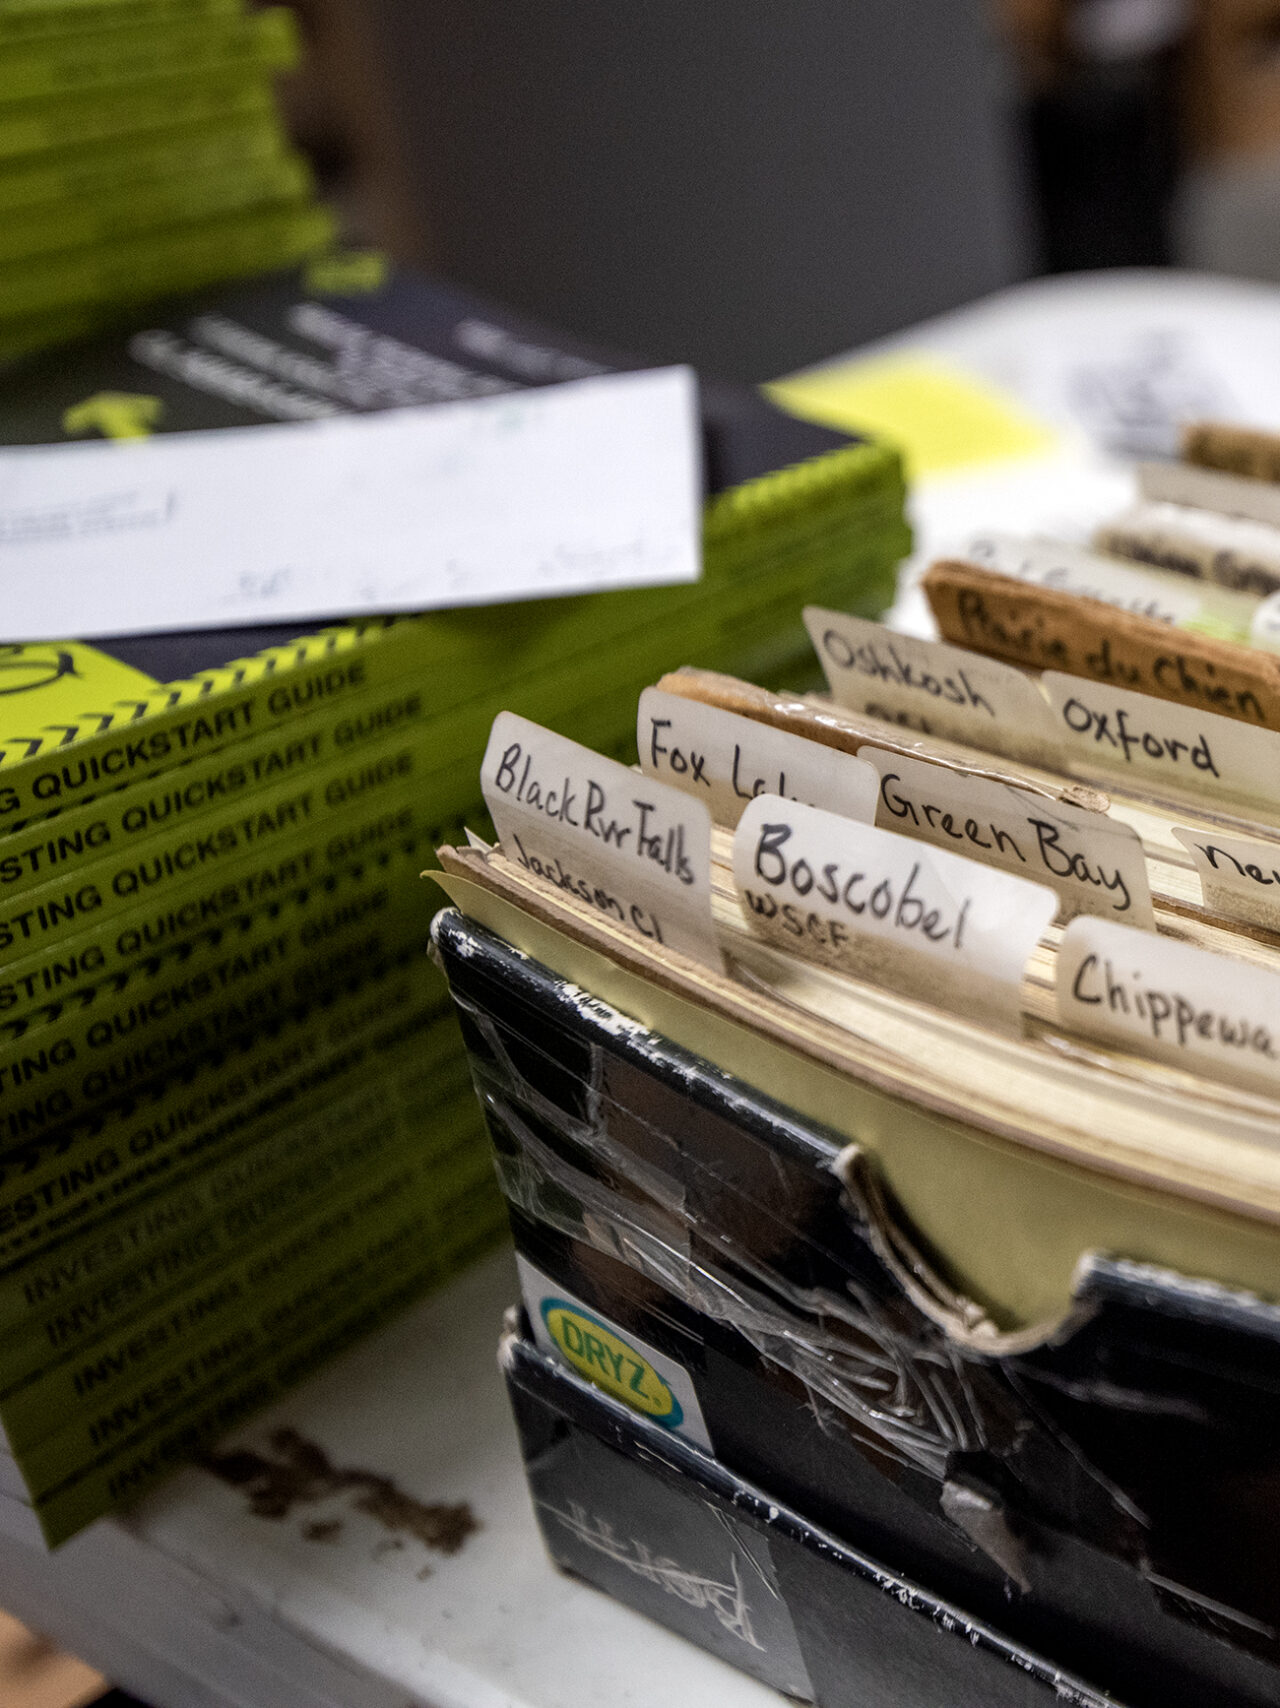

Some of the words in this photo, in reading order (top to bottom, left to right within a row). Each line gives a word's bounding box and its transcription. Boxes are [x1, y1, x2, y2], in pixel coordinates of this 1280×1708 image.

[822, 628, 996, 718] Oshkosh
[31, 701, 254, 800] QUICKSTART
[267, 661, 367, 715] GUIDE
[495, 742, 578, 827] Black
[650, 717, 711, 787] Fox
[1063, 697, 1221, 779] Oxford
[0, 821, 111, 884] STING
[121, 732, 322, 834] QUICKSTART
[333, 694, 422, 749] GUIDE
[112, 786, 312, 898] QUICKSTART
[325, 749, 414, 804] GUIDE
[880, 773, 1027, 863] Green
[1027, 816, 1132, 911] Bay
[116, 853, 314, 957] QUICKSTART
[512, 833, 625, 921] Jackson
[753, 821, 973, 950] Boscobel
[86, 933, 287, 1049] QUICKSTART
[1072, 953, 1279, 1061] Chippewa
